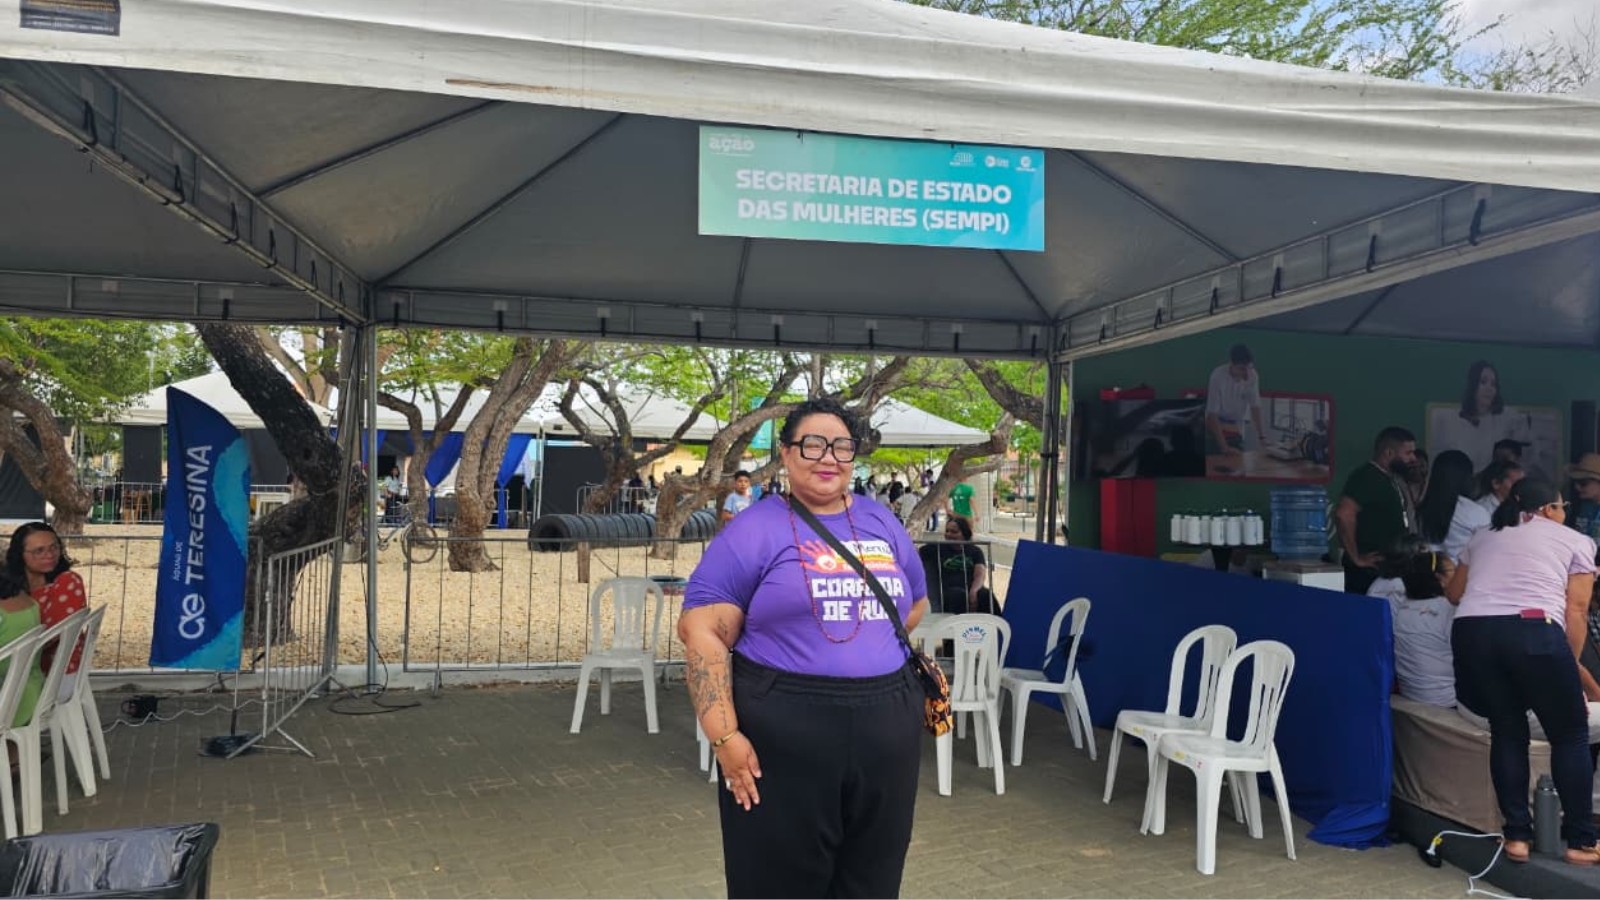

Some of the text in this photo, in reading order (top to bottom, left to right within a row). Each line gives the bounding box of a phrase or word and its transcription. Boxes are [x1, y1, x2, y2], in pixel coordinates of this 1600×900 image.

[736, 170, 1012, 204] SECRETARIA DE ESTADO
[738, 198, 1010, 234] DAS MULHERES (SEMPI)
[185, 445, 212, 585] TERESINA
[811, 576, 904, 598] CORRDA
[822, 600, 897, 620] DE RU
